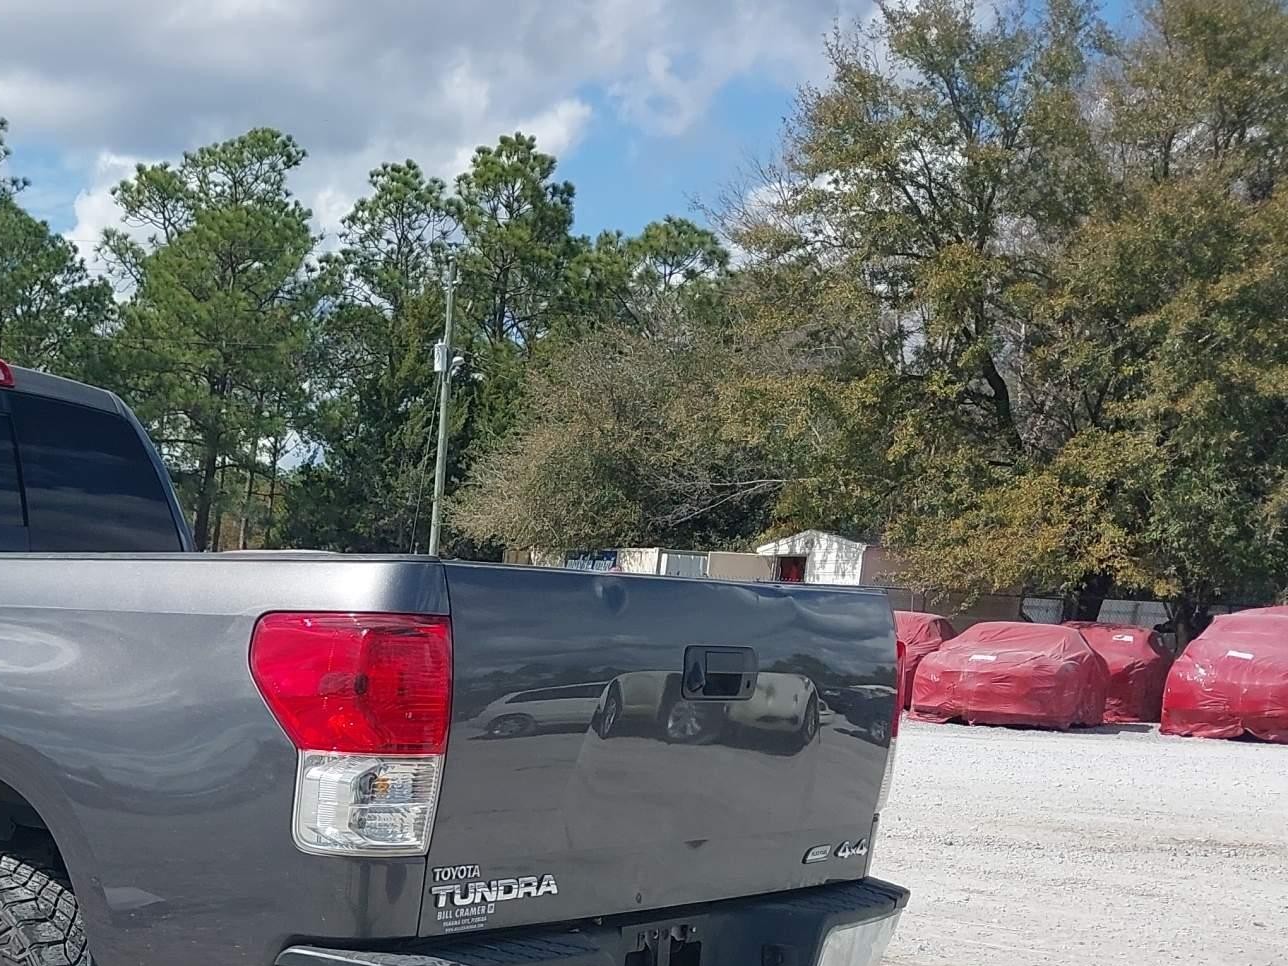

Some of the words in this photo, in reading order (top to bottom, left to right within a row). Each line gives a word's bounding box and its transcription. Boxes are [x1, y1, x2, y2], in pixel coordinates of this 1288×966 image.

[433, 865, 481, 881] TOYOTA
[431, 874, 558, 908] TUNDRA
[437, 910, 453, 920] BILL
[455, 905, 486, 918] CRAMER
